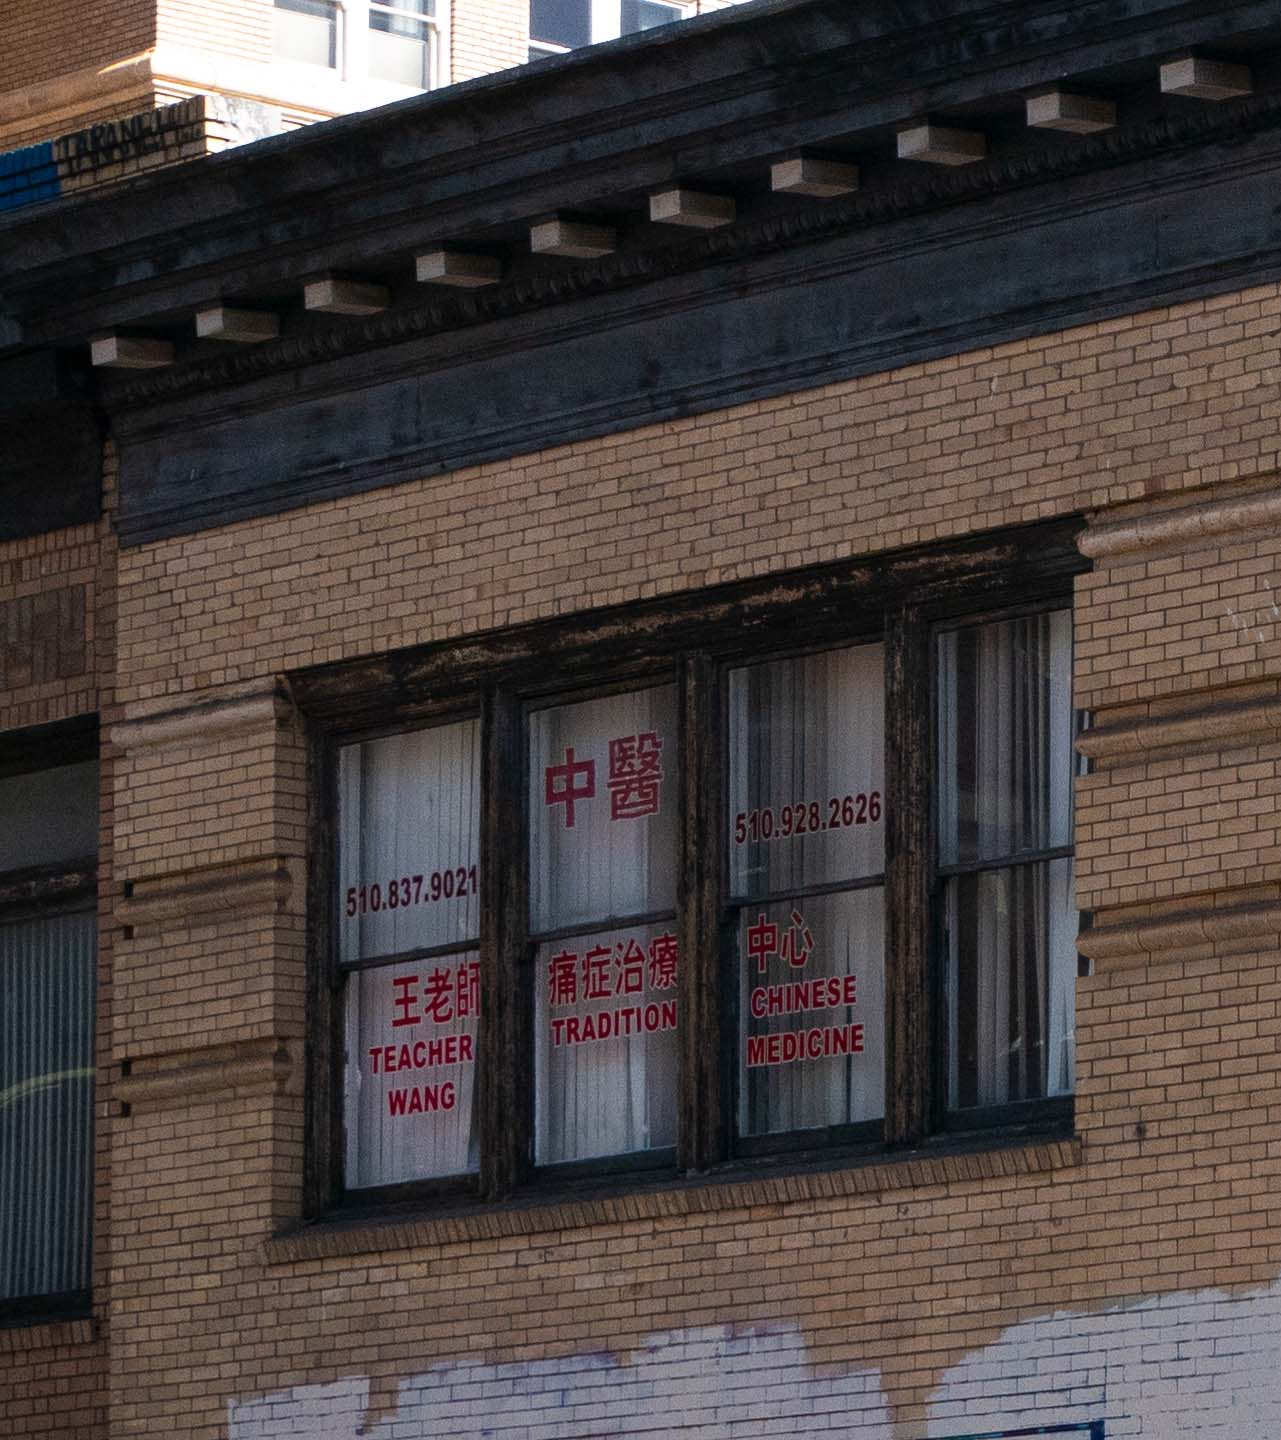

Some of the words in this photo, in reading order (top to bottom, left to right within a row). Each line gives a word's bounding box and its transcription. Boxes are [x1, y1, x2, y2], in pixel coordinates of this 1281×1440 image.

[544, 731, 663, 828] 中醫
[734, 791, 881, 844] 510.928.2626
[346, 865, 479, 917] 510.837.9021
[747, 911, 813, 973] 中心
[391, 961, 481, 1028] 王老師
[548, 933, 678, 1006] 痛症治療
[750, 975, 857, 1019] CHINESE
[552, 1000, 677, 1047] TRADITION
[745, 1024, 864, 1067] MEDICINE
[369, 1034, 473, 1075] TEACHER
[388, 1082, 456, 1117] WANG
